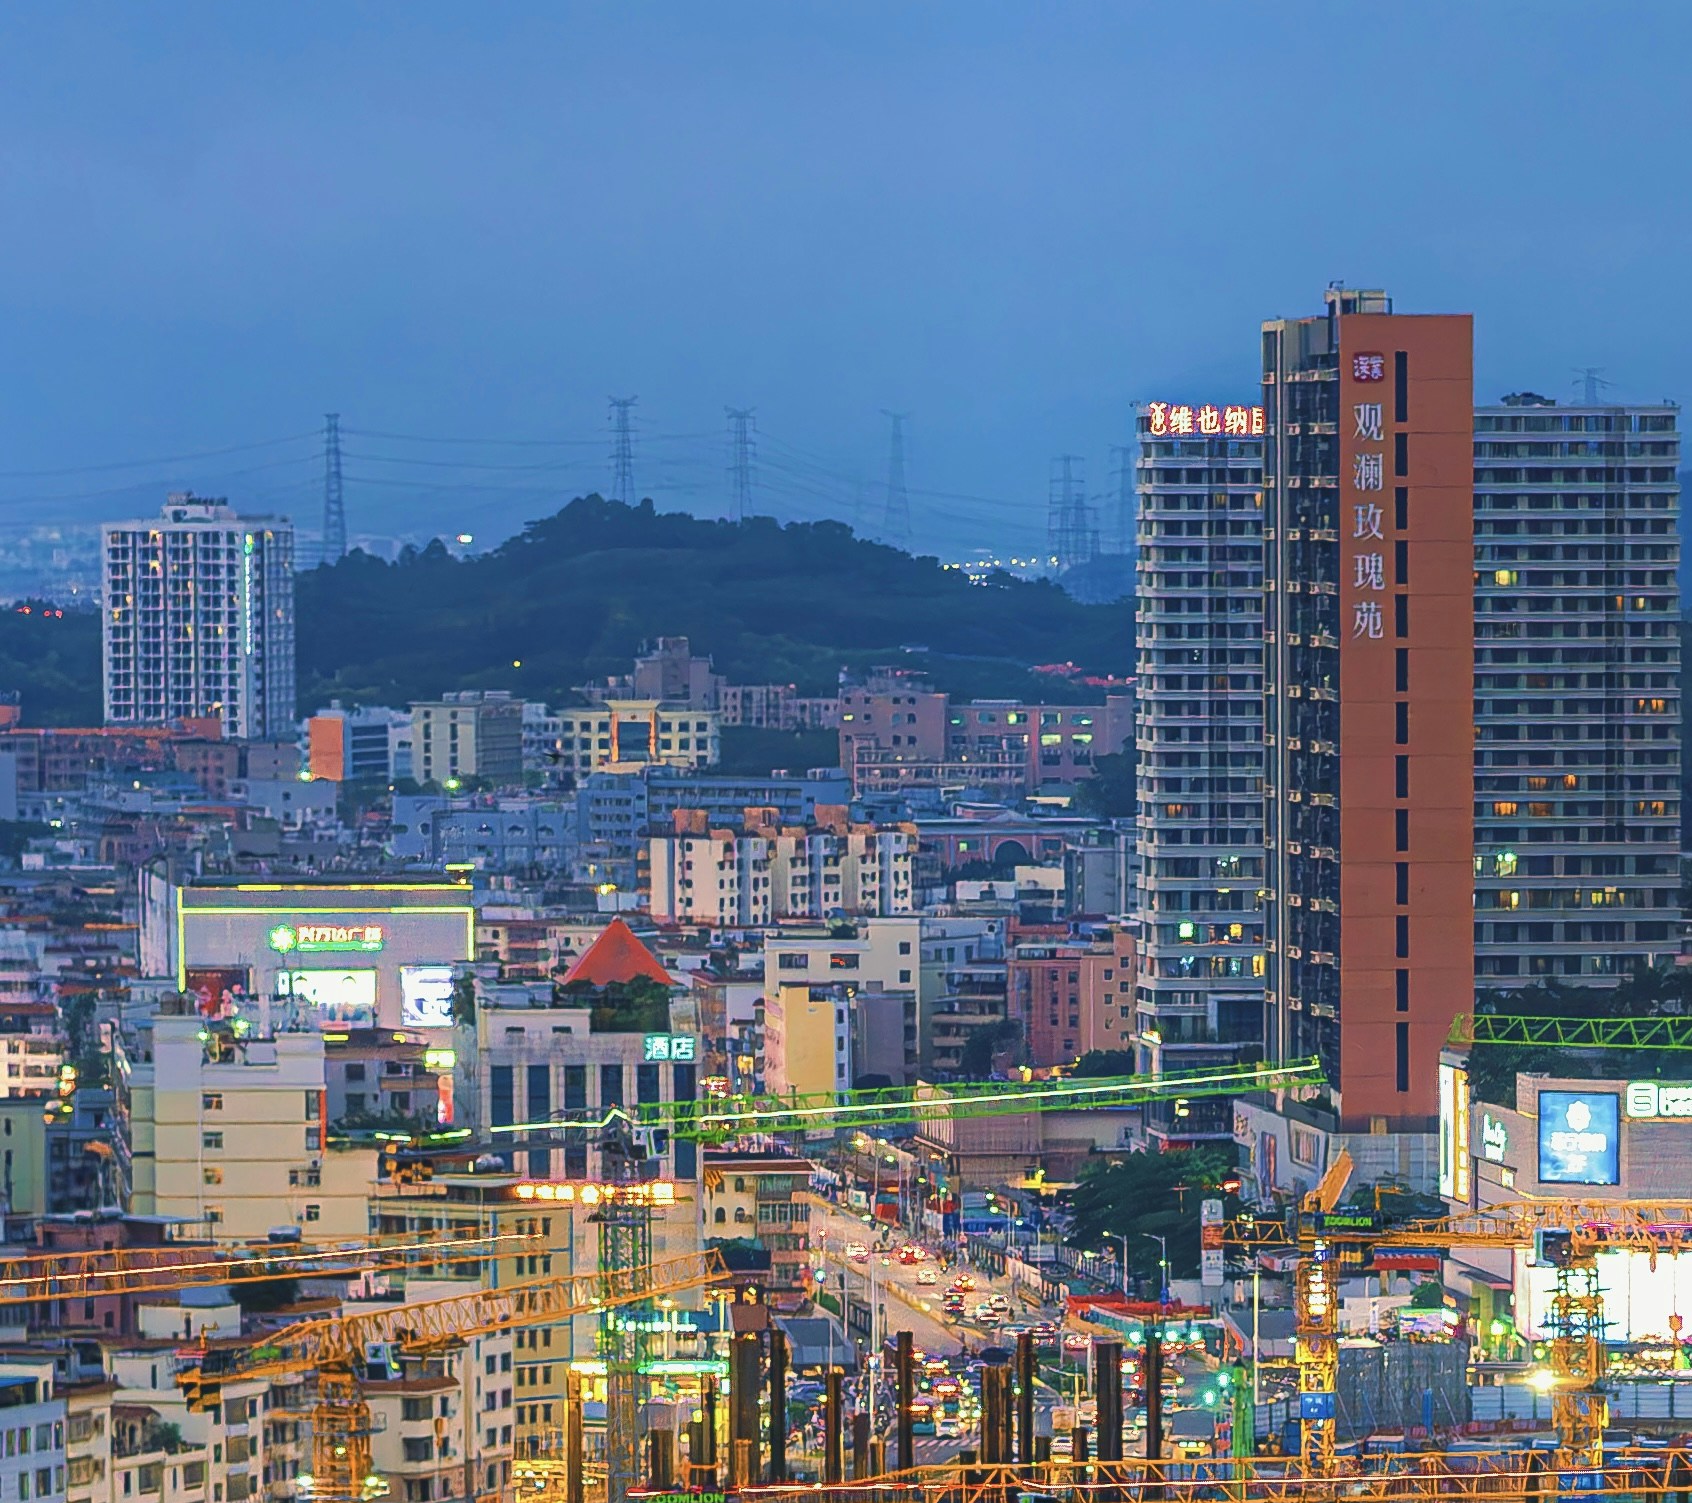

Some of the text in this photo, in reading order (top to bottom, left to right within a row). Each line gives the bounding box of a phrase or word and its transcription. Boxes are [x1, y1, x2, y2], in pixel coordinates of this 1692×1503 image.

[1353, 403, 1385, 639] 观澜玫瑰苑
[644, 1034, 694, 1061] 酒店
